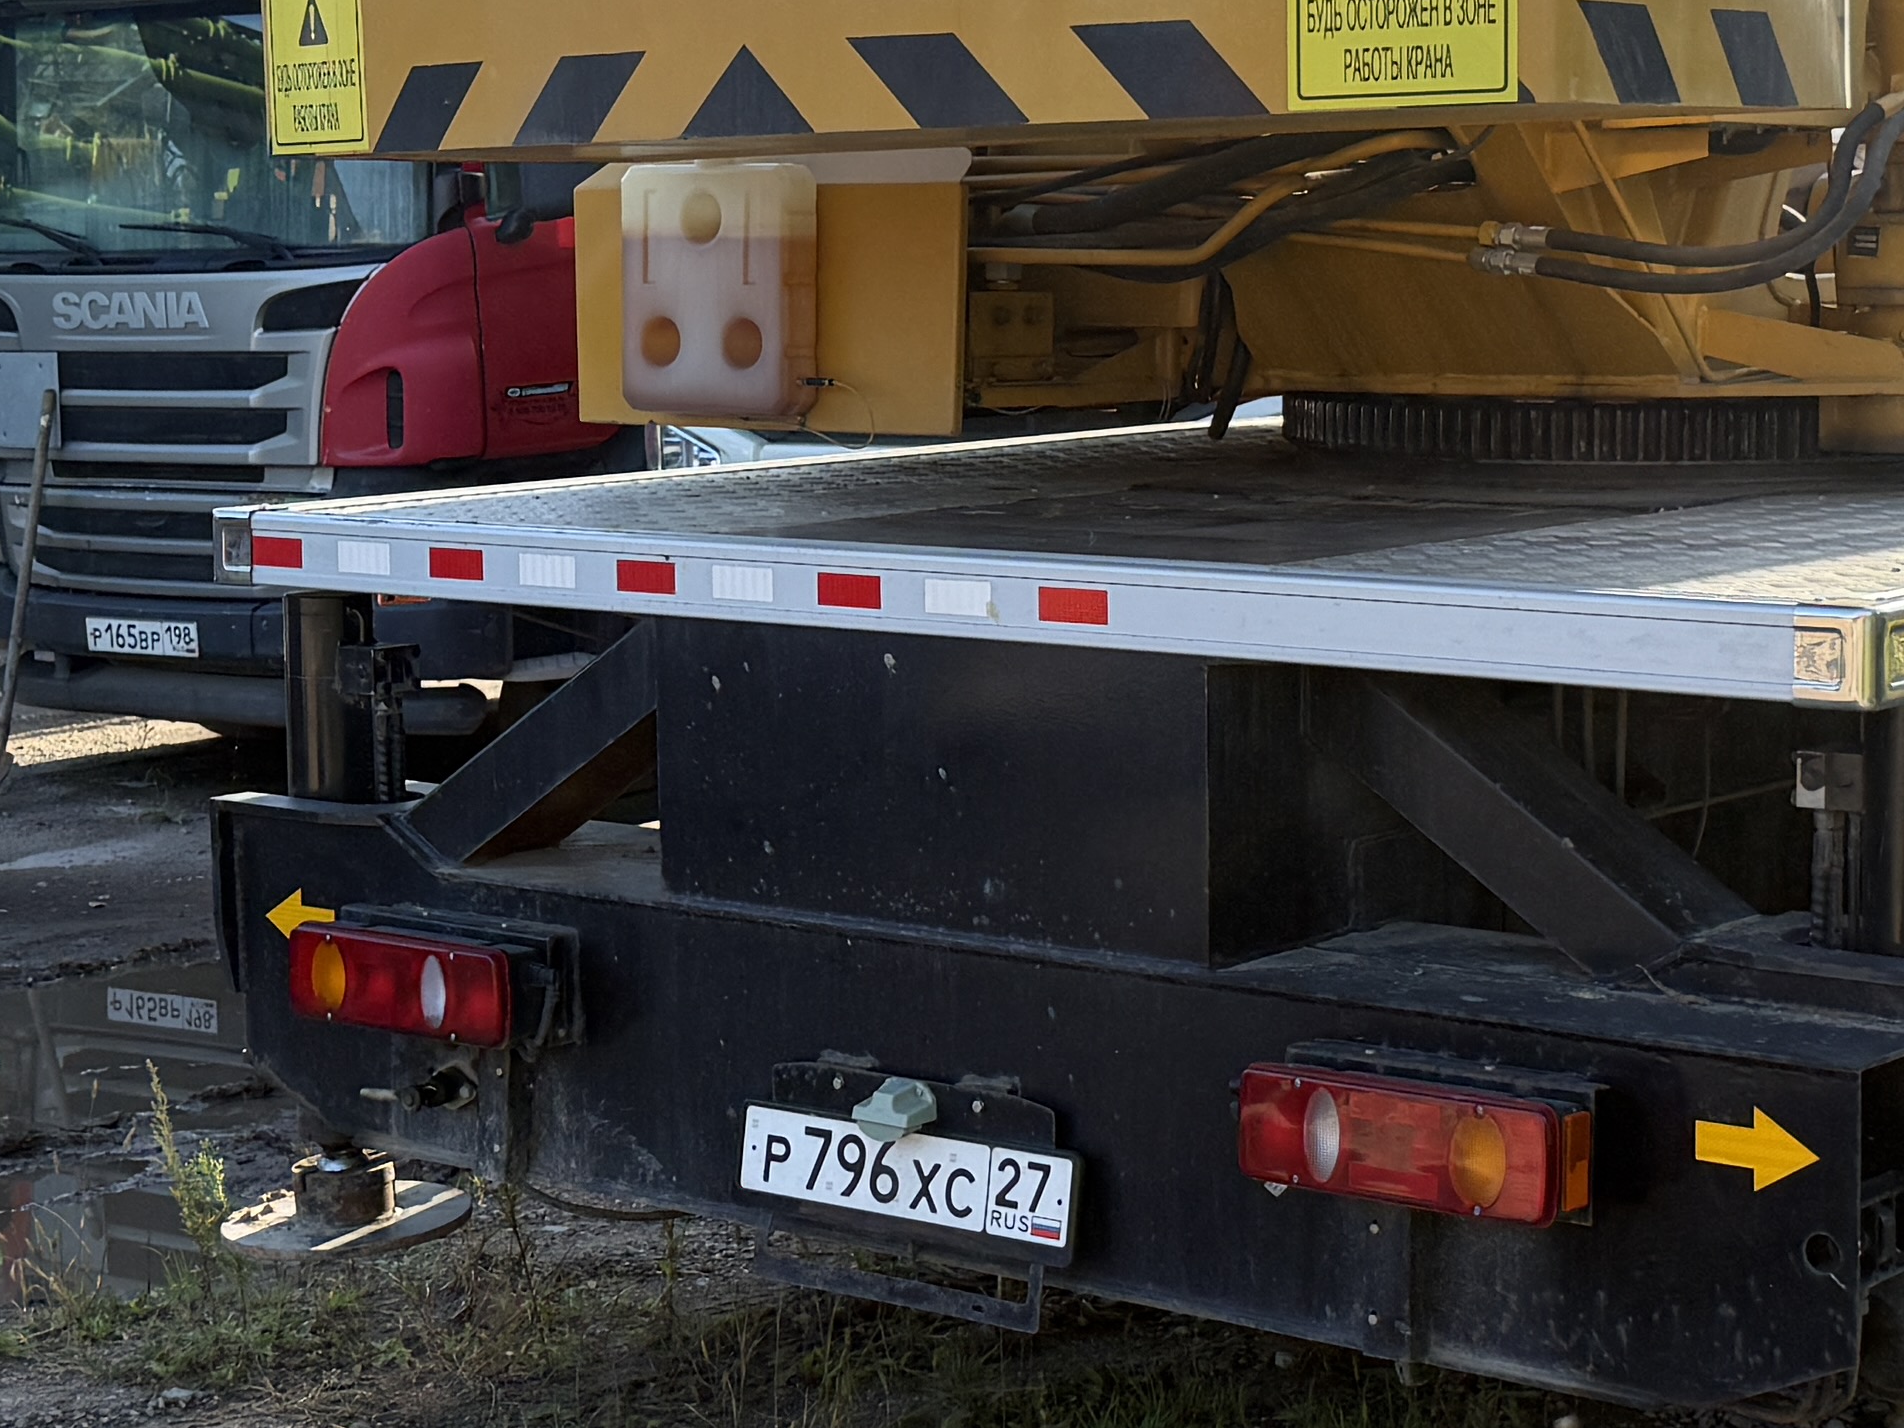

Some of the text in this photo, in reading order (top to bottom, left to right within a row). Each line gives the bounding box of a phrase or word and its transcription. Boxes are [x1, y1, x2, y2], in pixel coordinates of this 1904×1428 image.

[1344, 44, 1454, 83] РАБОТЫ КРАНА
[52, 290, 210, 330] SCANIA
[990, 1209, 1030, 1234] RUS
